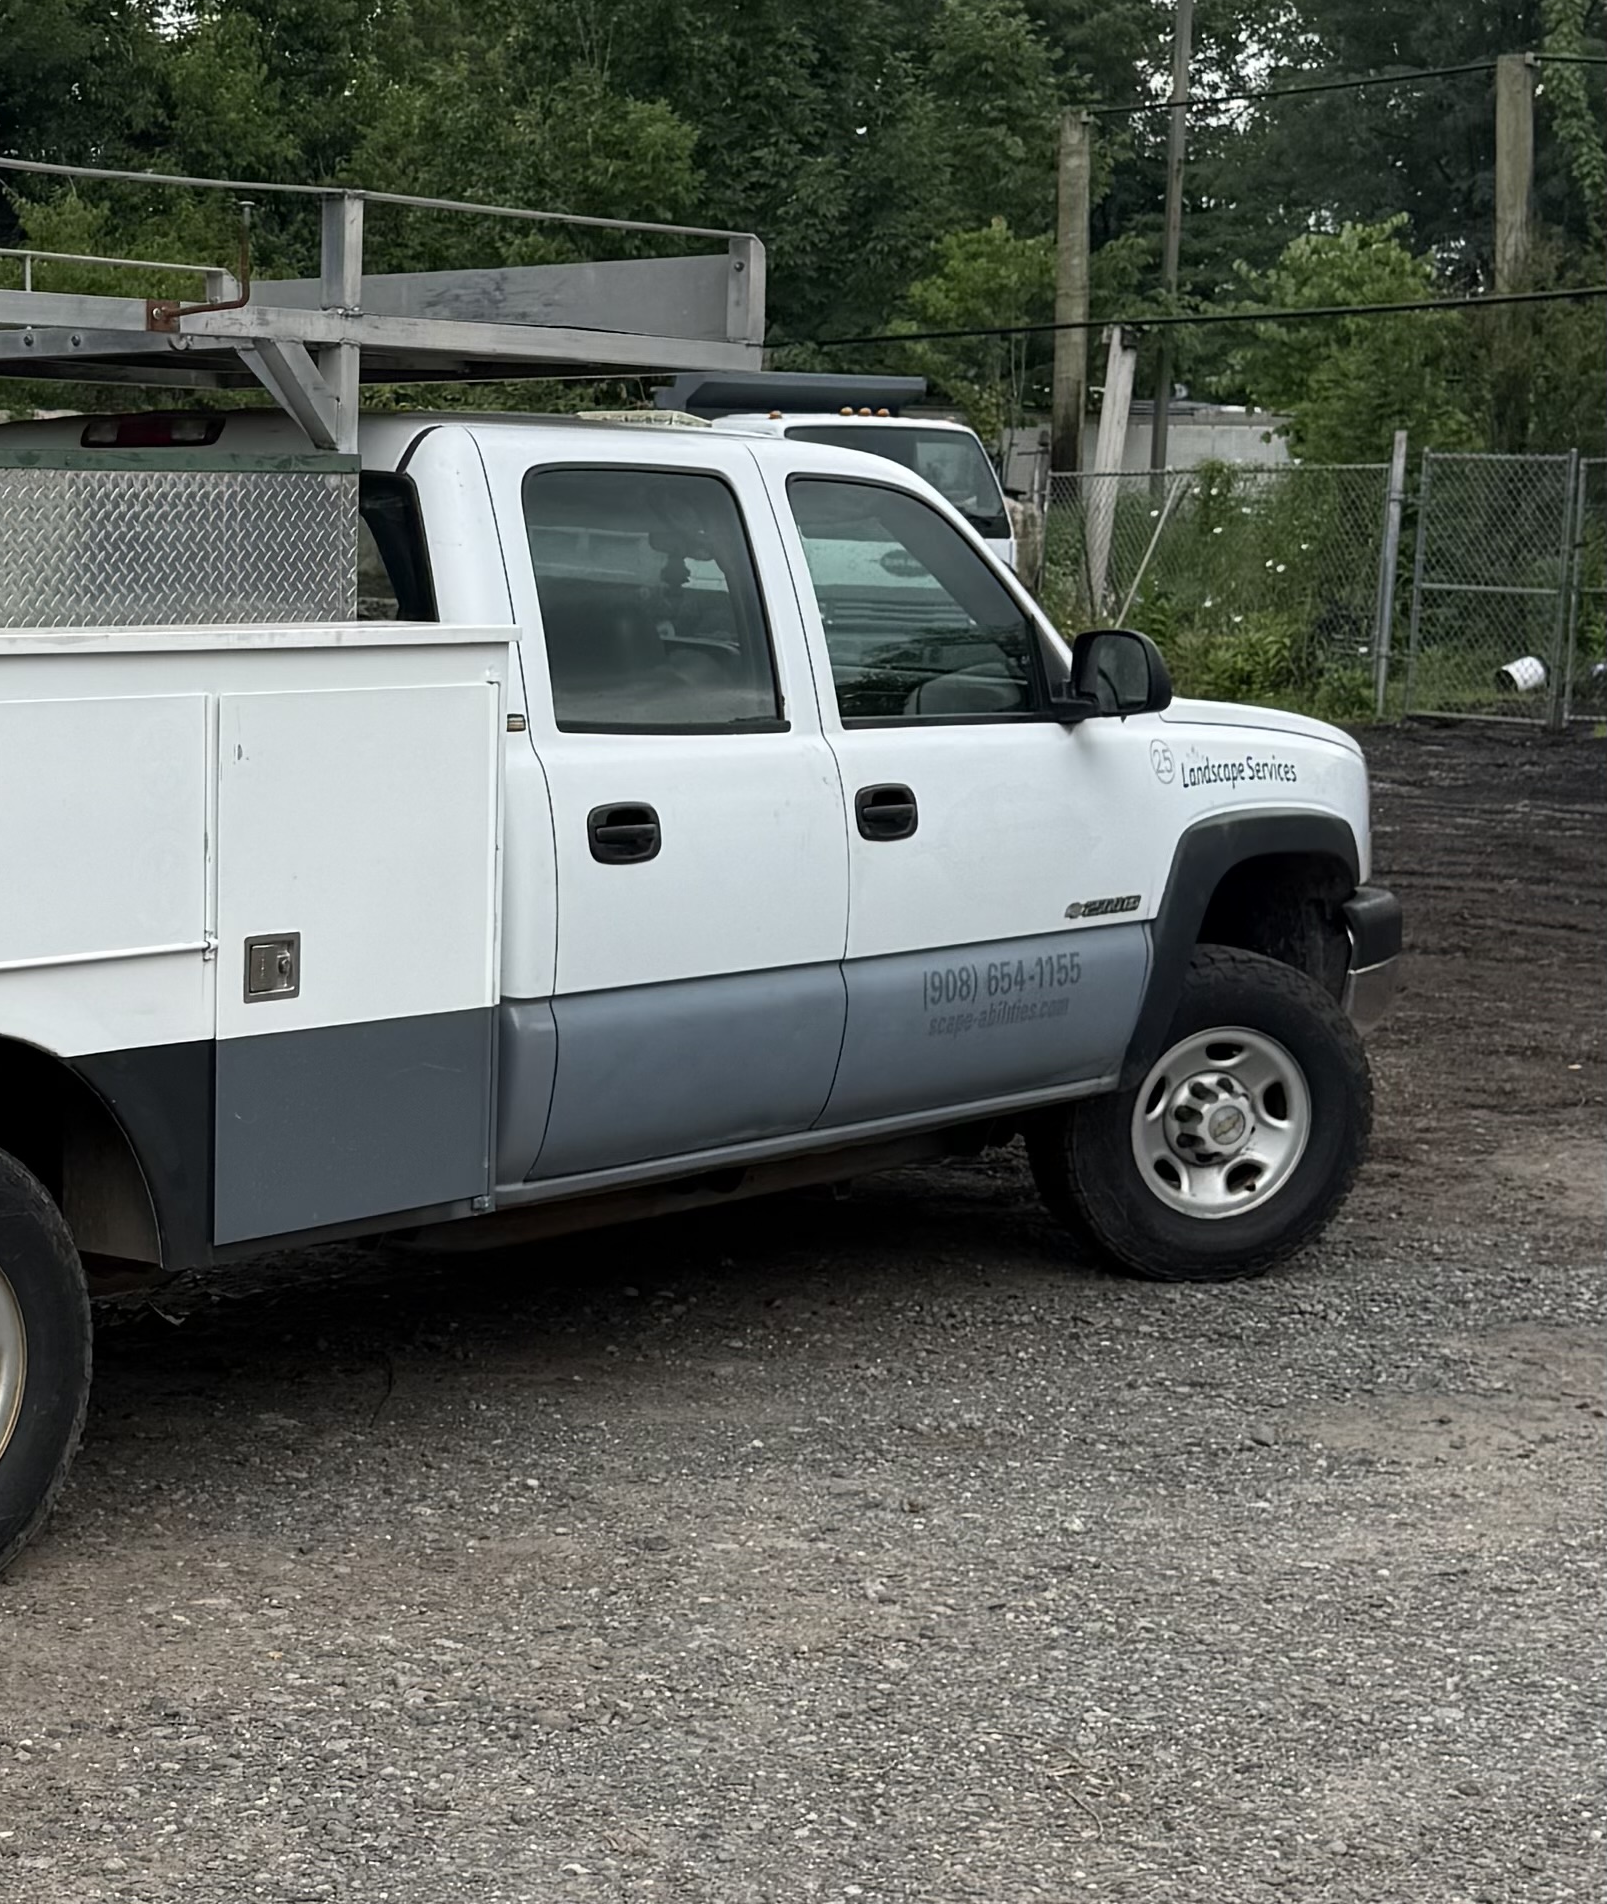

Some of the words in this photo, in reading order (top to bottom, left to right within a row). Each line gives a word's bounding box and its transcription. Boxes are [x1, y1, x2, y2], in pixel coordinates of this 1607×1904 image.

[1152, 749, 1173, 774] 25
[1181, 756, 1245, 789] Landscape
[1246, 755, 1297, 782] Services
[923, 964, 978, 1012] (908)
[987, 951, 1082, 997] 654-1155
[929, 997, 1070, 1039] scape-abilities.com
